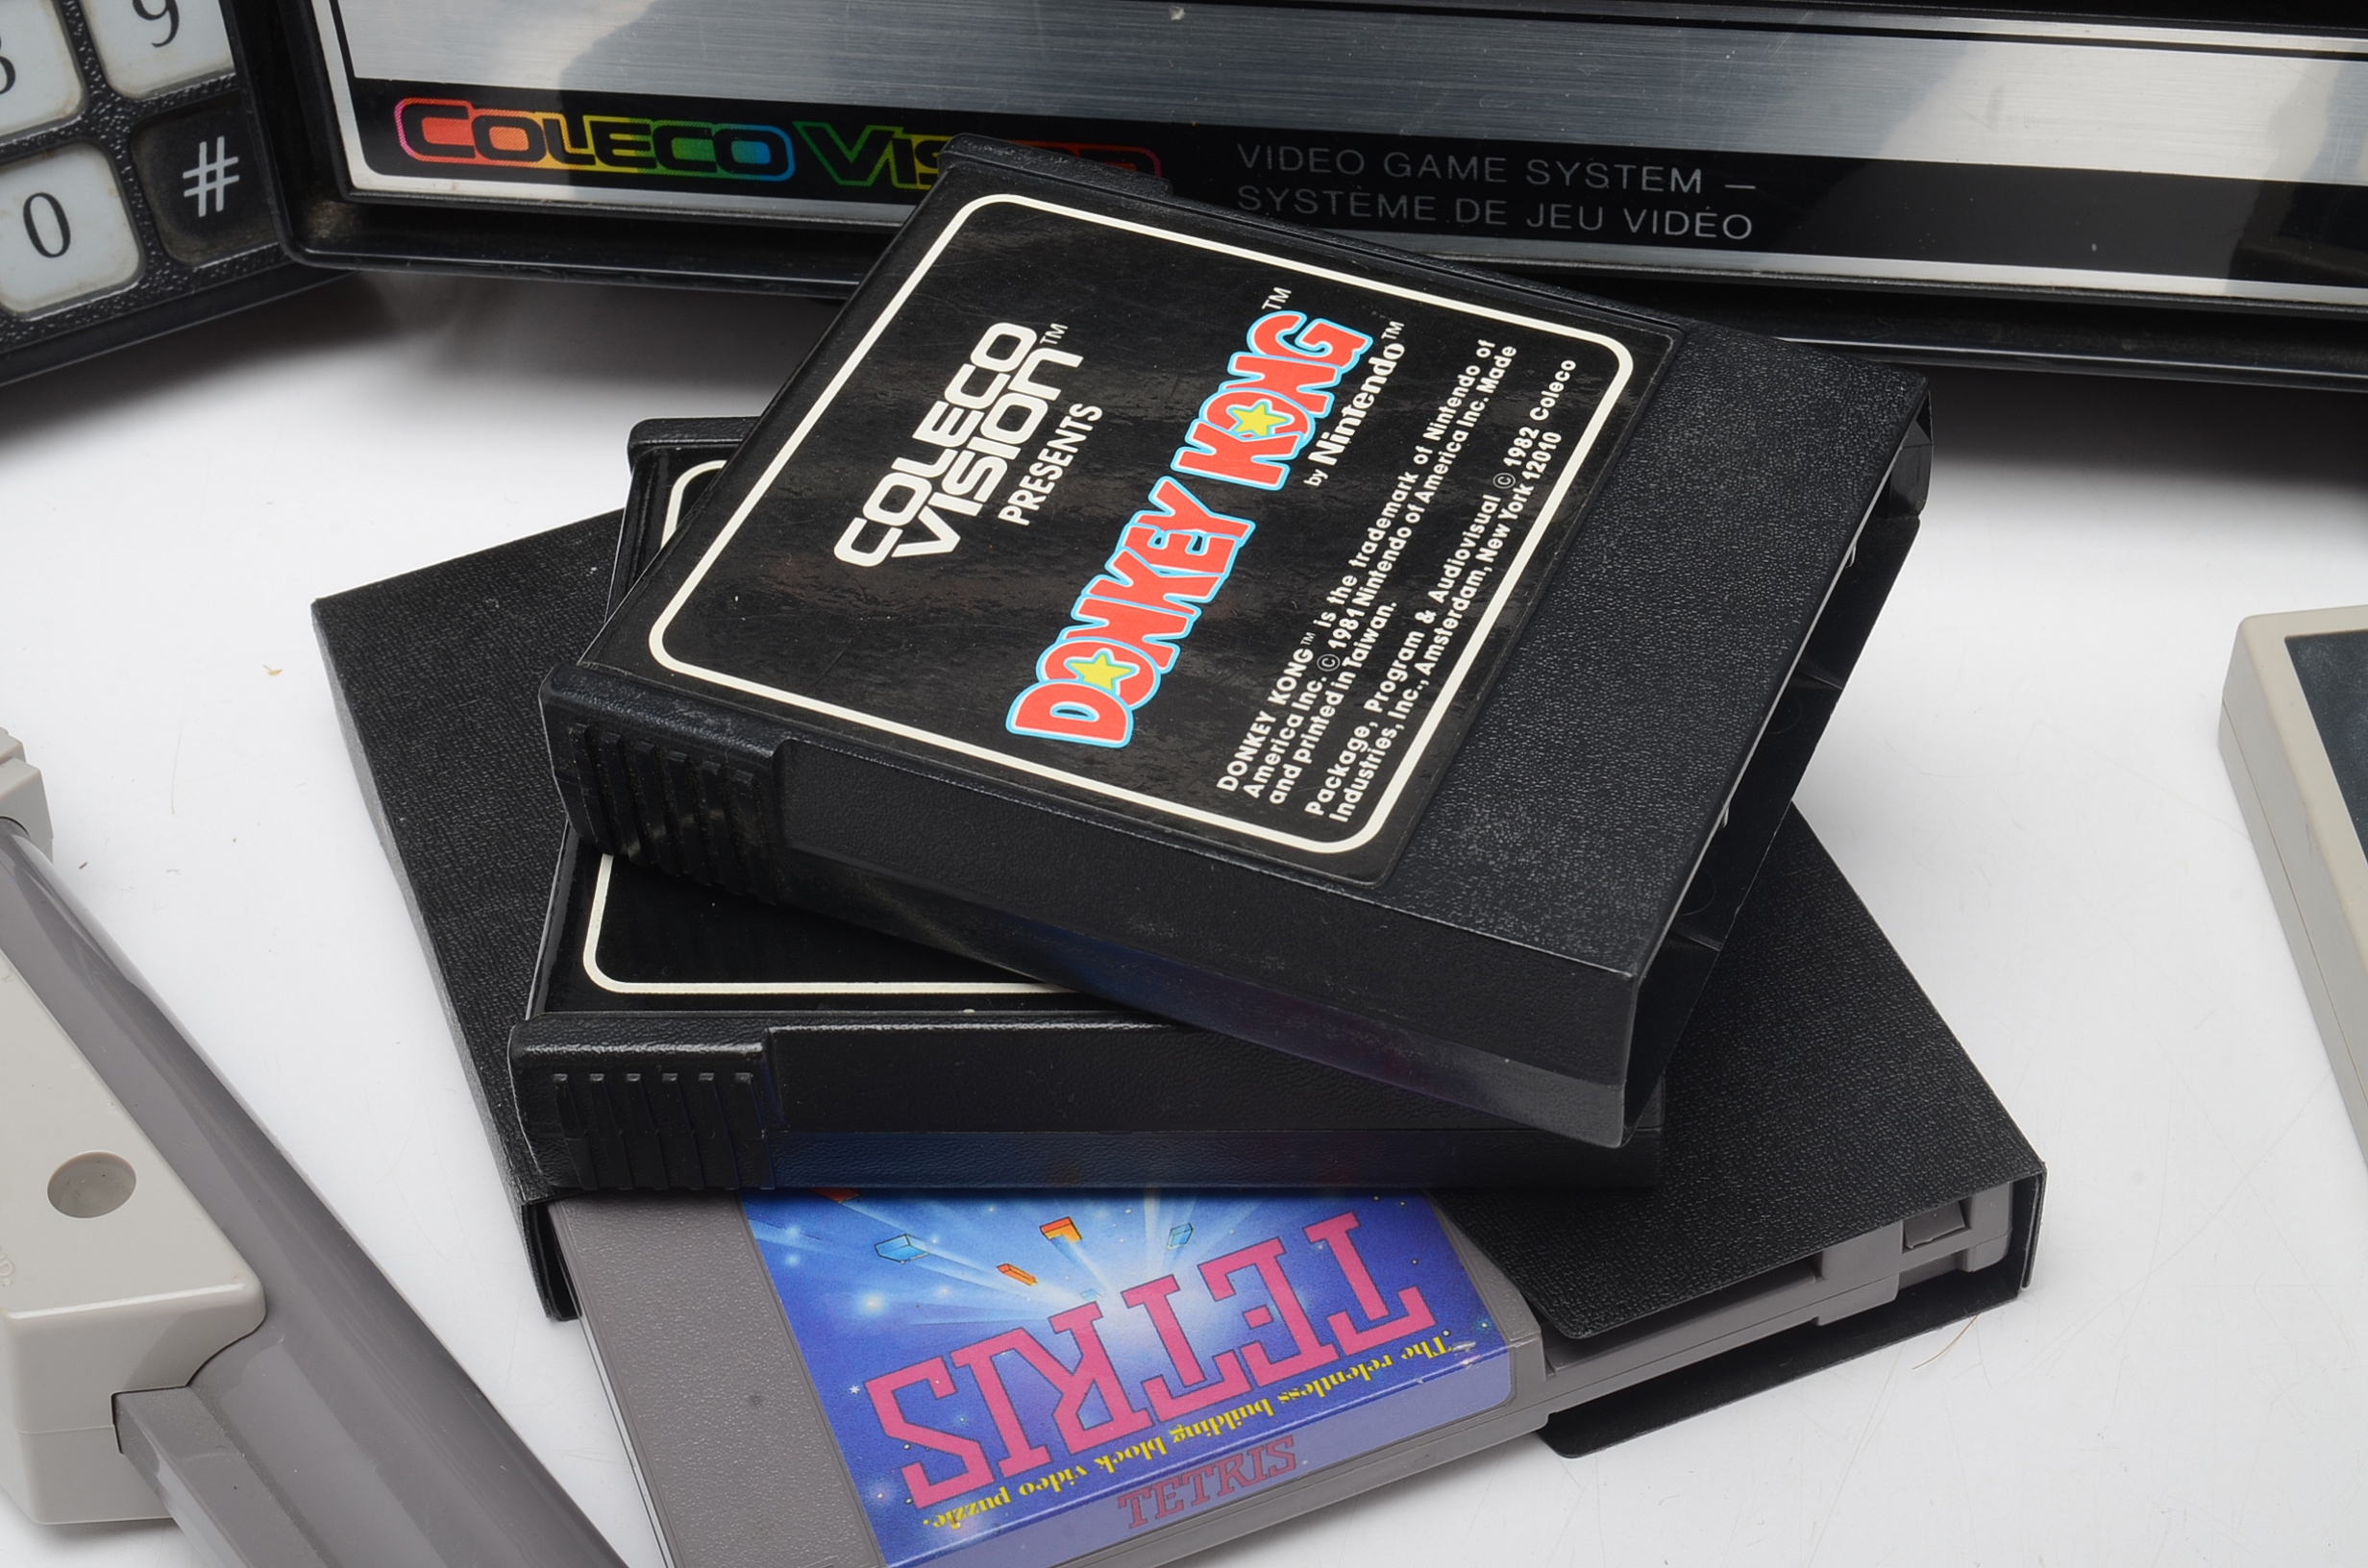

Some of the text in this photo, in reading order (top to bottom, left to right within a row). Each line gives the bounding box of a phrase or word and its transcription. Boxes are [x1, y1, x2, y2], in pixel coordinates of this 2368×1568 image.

[393, 96, 796, 183] COLECO
[1236, 142, 1366, 176] VIDEO
[1383, 151, 1508, 184] GAME
[1524, 158, 1703, 195] SYSTEM
[1454, 196, 1508, 227] DE
[1525, 203, 1604, 233] JEU
[1475, 346, 1517, 393] Made
[1476, 339, 1495, 357] of
[1307, 337, 1405, 465] Nintendo
[1422, 364, 1480, 440] Nintendo
[1456, 397, 1489, 427] Inc.
[833, 321, 1037, 567] COLECO
[891, 347, 1083, 557] VISION
[998, 403, 1102, 525] PRESENTS
[1303, 468, 1328, 486] by
[1413, 445, 1433, 464] of
[1414, 429, 1468, 503] America
[1005, 475, 1256, 747] DONKEY
[1170, 310, 1373, 490] KONG
[1348, 471, 1418, 567] trademark
[1405, 502, 1425, 523] of
[1304, 721, 1378, 815] Package,
[1363, 630, 1425, 712] Program
[1415, 609, 1437, 624] &
[1427, 494, 1501, 603] Audiovisual
[1503, 426, 1540, 466] 1982
[1529, 359, 1576, 420] Coleco
[1325, 575, 1357, 604] the
[1351, 526, 1412, 606] Nintendo
[1313, 611, 1337, 627] is
[1327, 607, 1365, 648] 1981
[1328, 431, 1562, 821] Industries, Inc., Amsterdam, New York 12010
[1267, 648, 1314, 704] KONG
[1269, 601, 1396, 803] and printed in Taiwan.
[1291, 676, 1327, 710] Inc.
[1216, 709, 1276, 791] DONKEY
[1242, 713, 1304, 797] America
[864, 1210, 1440, 1509] TETRIS
[923, 1336, 1453, 1529] The relentless building block video puzzle.
[1118, 1433, 1297, 1530] TETRIS
